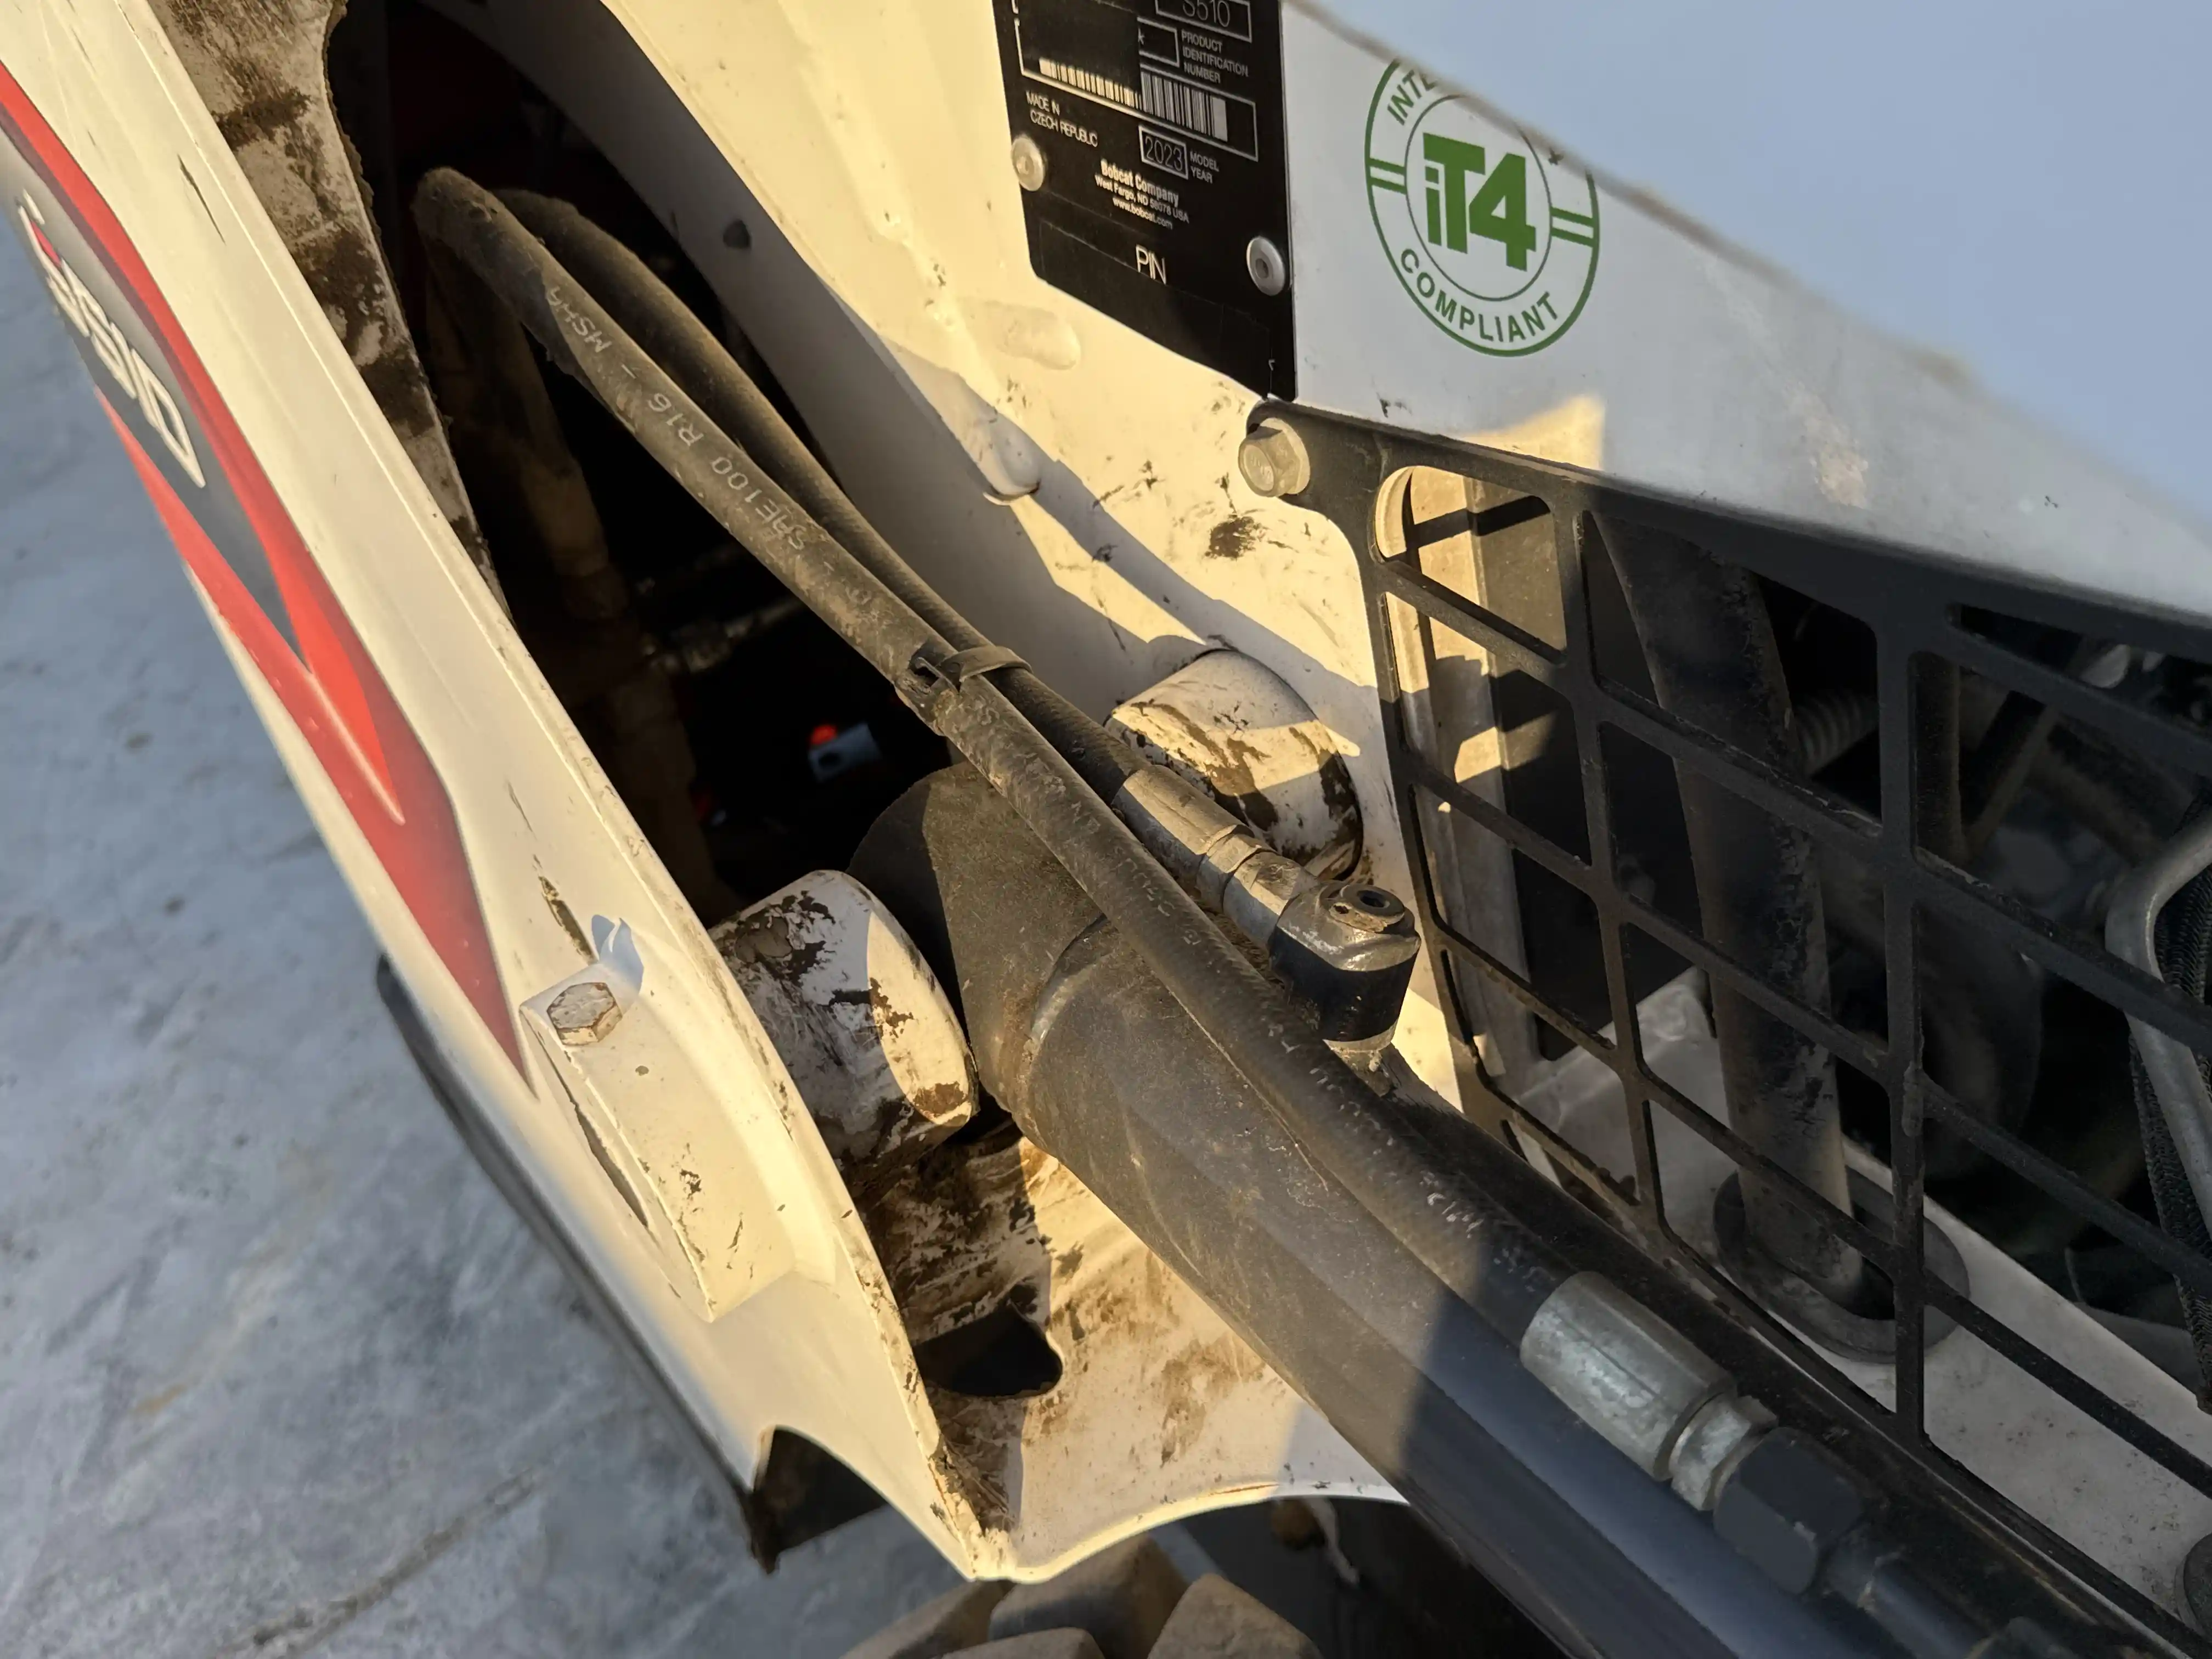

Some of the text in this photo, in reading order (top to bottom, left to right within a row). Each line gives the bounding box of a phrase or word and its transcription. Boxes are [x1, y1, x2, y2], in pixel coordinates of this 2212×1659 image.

[1183, 0, 1230, 27] S510
[1181, 29, 1222, 53] PRODUCT
[1183, 46, 1249, 77] IDENTIFICATION
[1184, 61, 1221, 83] NUMBER
[1026, 89, 1060, 116] MADE IN
[1030, 109, 1098, 147] CZECH REPUBLIC
[1146, 136, 1183, 171] 2023
[1190, 149, 1219, 172] MODEL
[1101, 157, 1179, 208] Bobcat Company
[1190, 166, 1213, 184] YEAR
[1094, 173, 1113, 192] West
[1113, 181, 1136, 202] Fargo,
[1137, 193, 1148, 206] ND
[1172, 206, 1189, 224] USA
[1112, 195, 1173, 230] www.bobcat.com
[1423, 132, 1537, 272] iT4
[1135, 245, 1166, 285] PIN
[1401, 248, 1558, 343] COMPLIANT
[647, 393, 705, 448] R16
